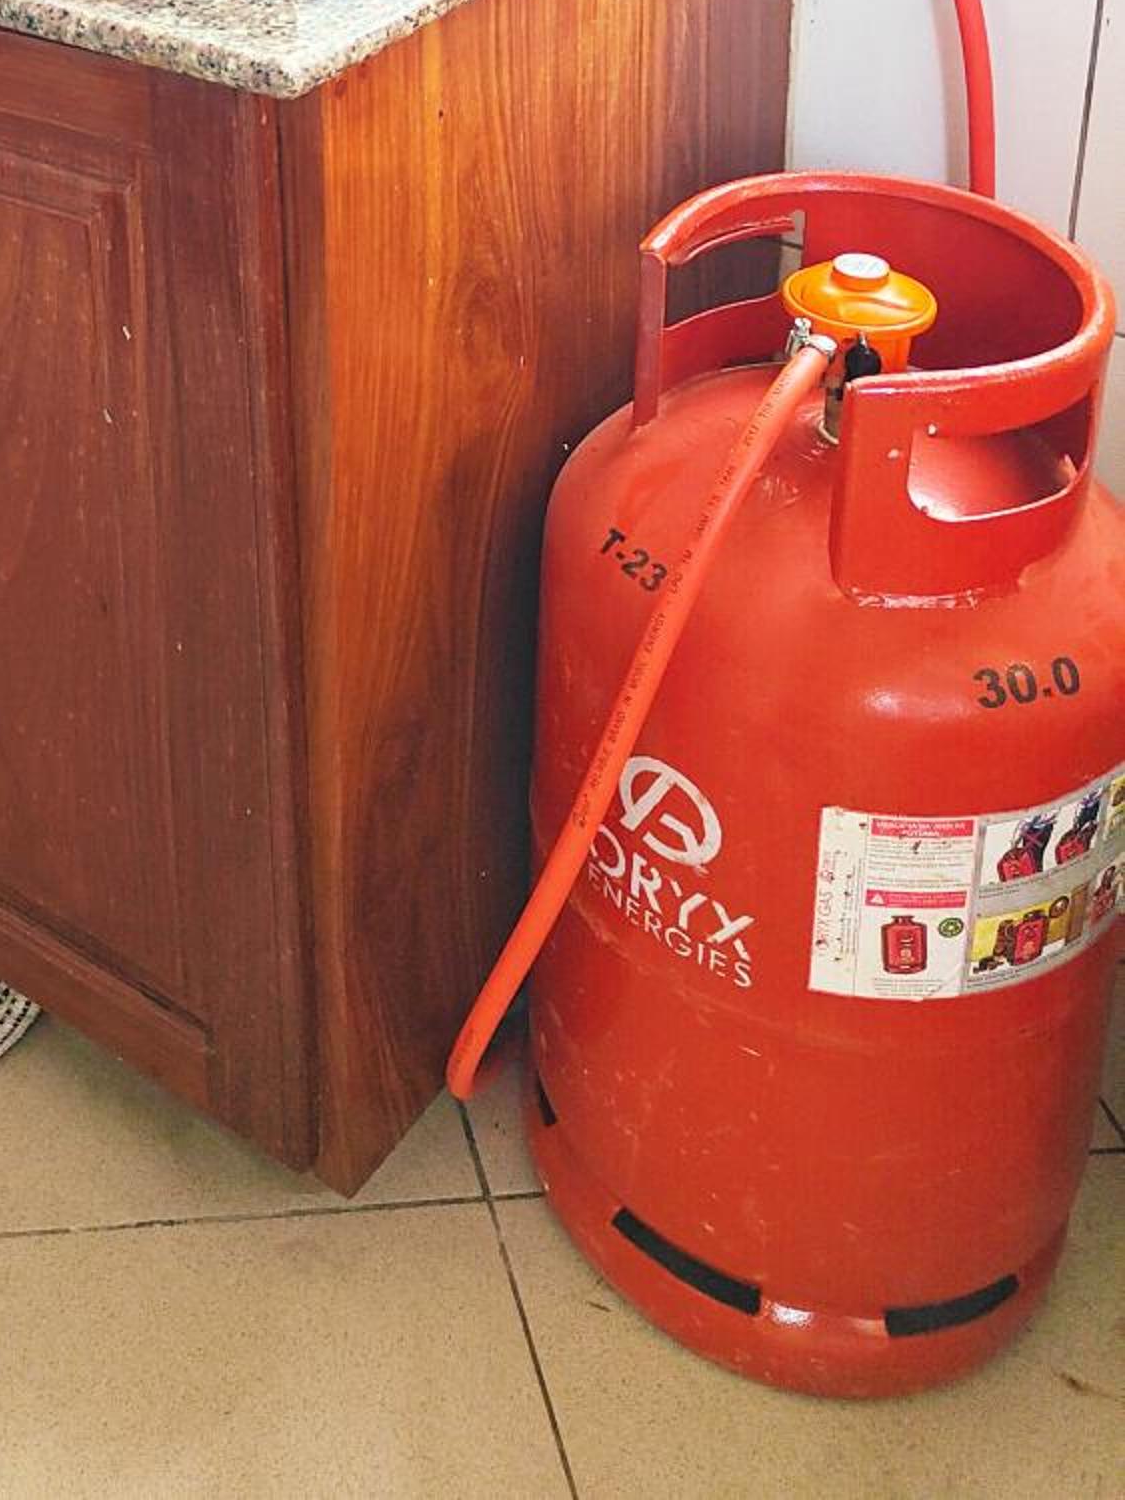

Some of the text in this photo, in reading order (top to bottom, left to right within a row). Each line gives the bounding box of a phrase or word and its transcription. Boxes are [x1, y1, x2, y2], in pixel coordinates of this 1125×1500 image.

[599, 527, 668, 592] T-23
[972, 656, 1081, 709] 30.0
[586, 861, 753, 988] ENERGIES
[589, 823, 756, 963] ORYX
